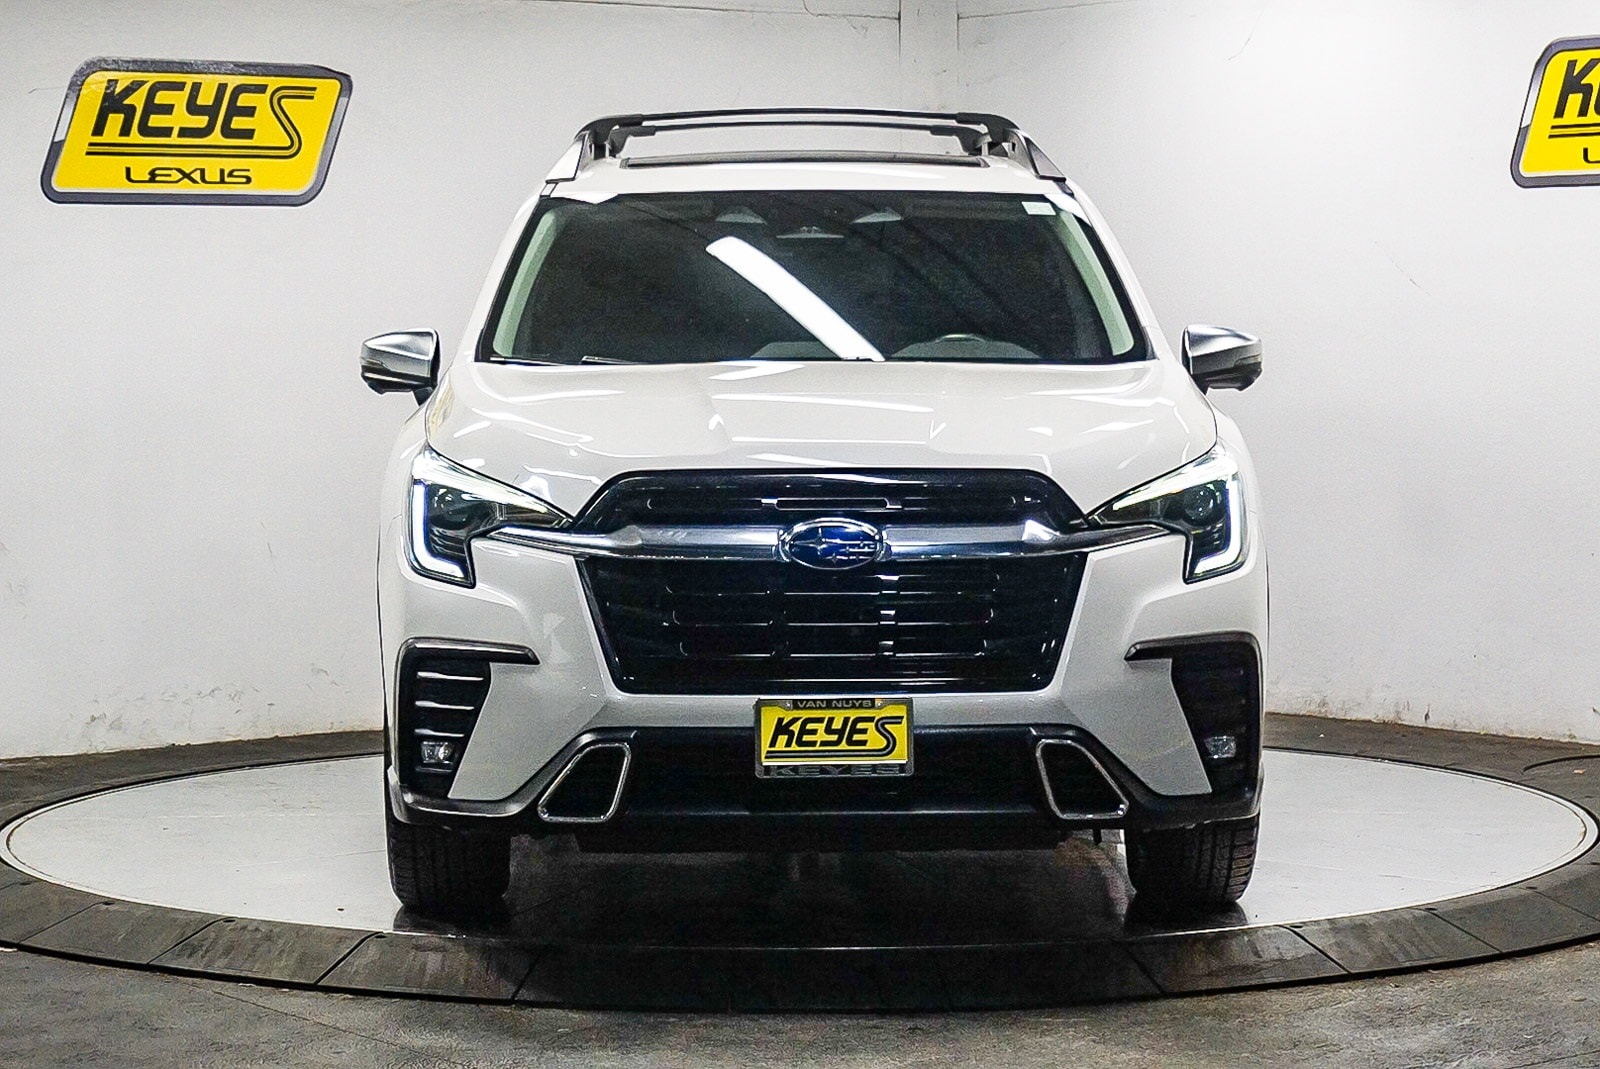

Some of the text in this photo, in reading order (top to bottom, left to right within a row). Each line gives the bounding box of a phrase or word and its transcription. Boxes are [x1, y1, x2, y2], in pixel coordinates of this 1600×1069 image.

[86, 79, 317, 159] KEYES
[125, 166, 252, 184] LEXUS
[797, 699, 872, 708] VAN NUYS
[764, 716, 905, 759] KEYES
